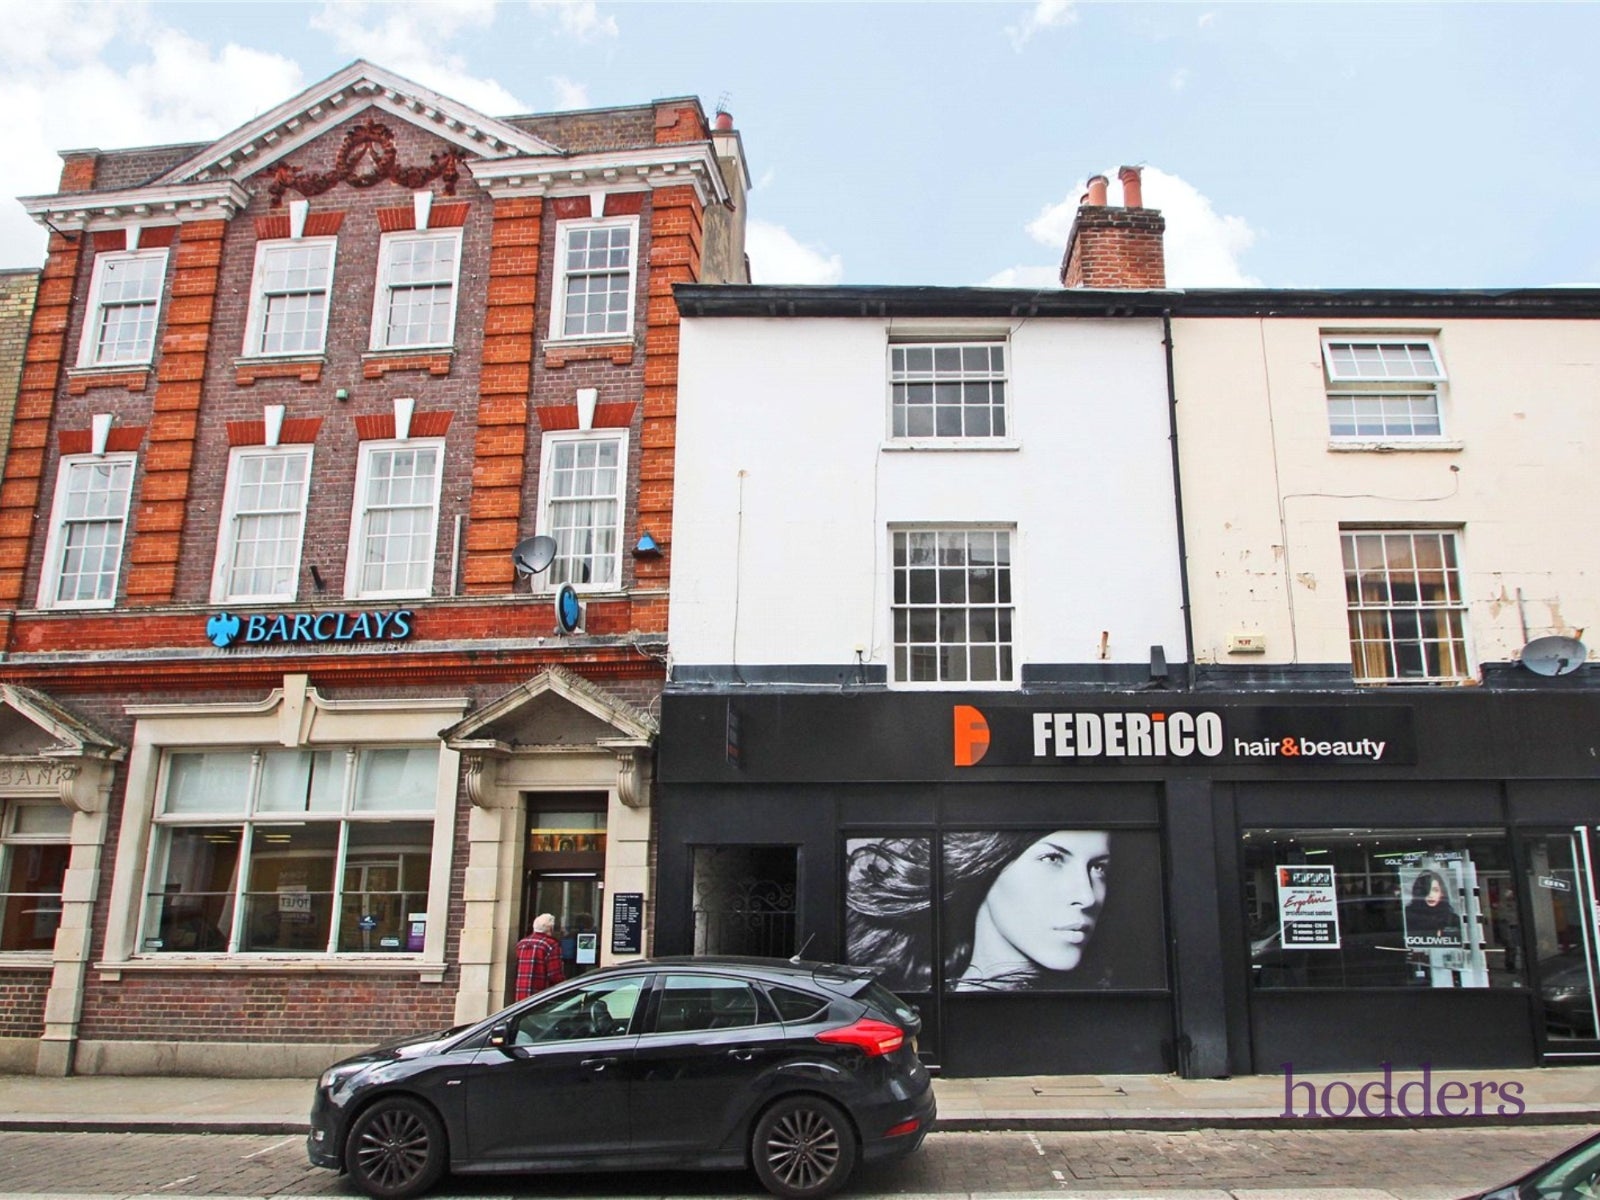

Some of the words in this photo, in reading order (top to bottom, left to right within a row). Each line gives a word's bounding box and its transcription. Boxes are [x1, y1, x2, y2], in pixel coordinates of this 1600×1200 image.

[245, 610, 411, 642] BARCLAYS
[1234, 737, 1386, 760] hair&beauty
[1406, 936, 1461, 945] GOLDWELL
